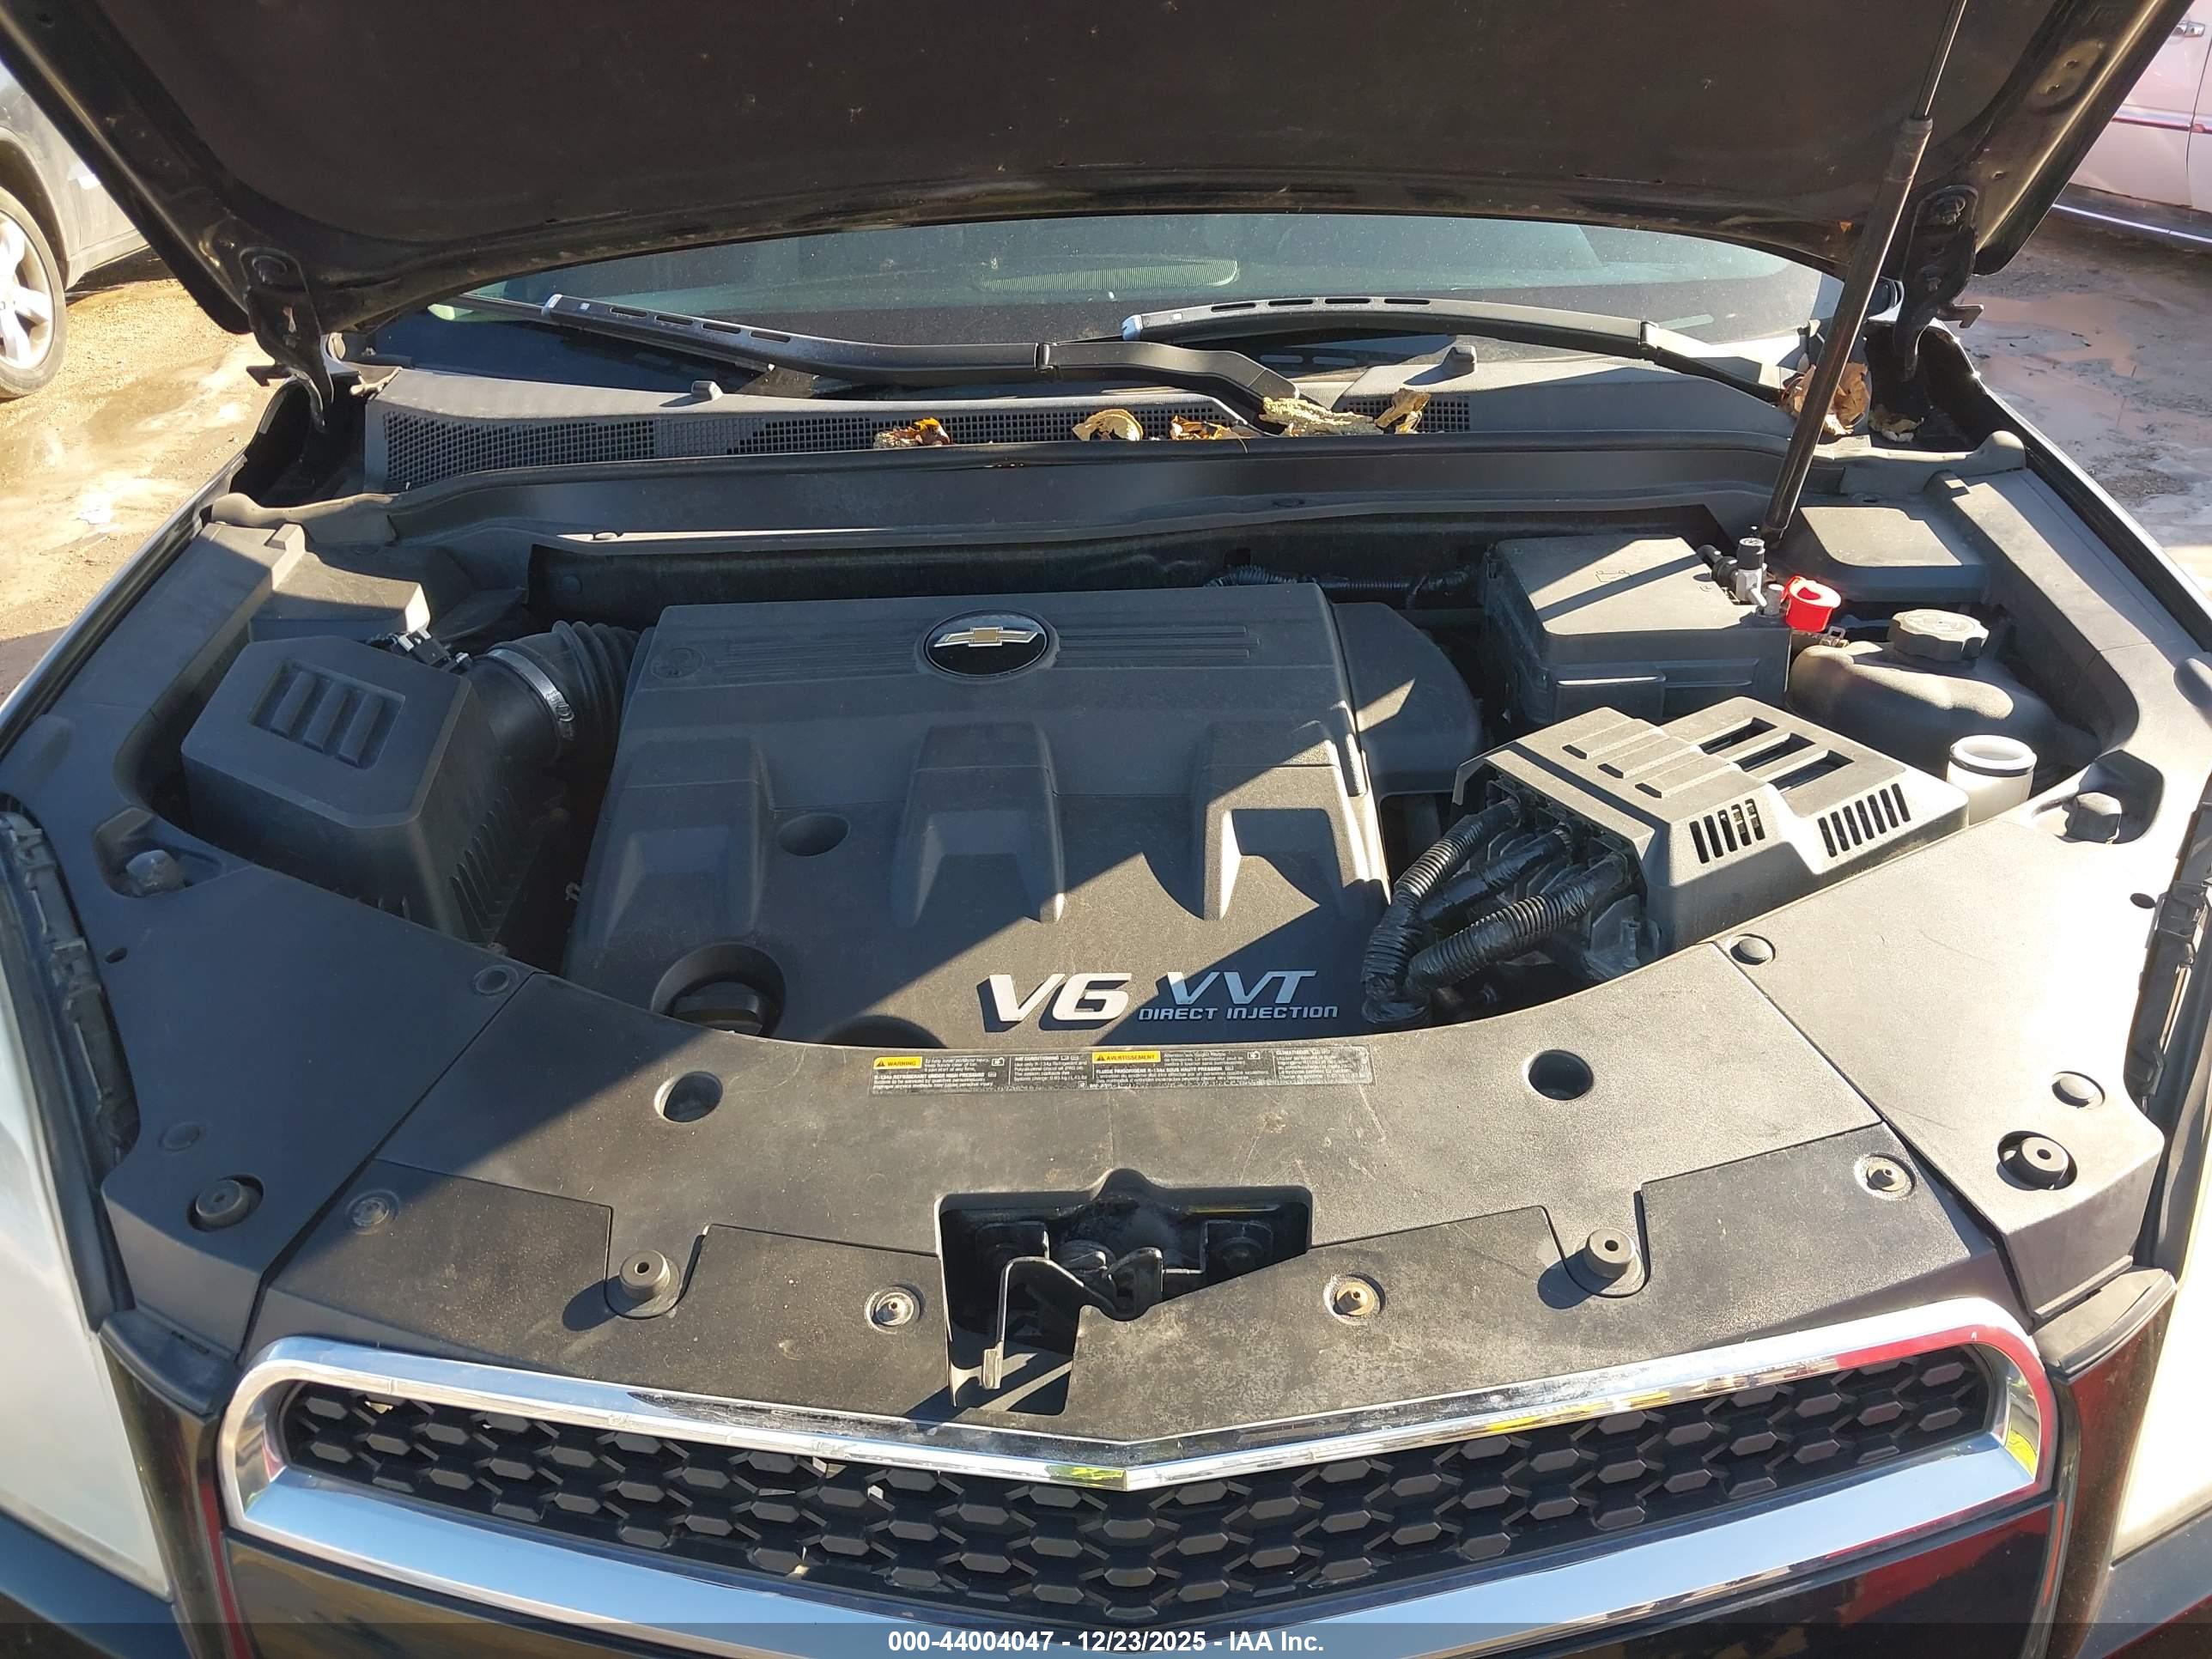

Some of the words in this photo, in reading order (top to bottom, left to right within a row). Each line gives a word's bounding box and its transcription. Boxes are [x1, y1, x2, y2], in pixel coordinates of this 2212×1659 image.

[988, 971, 1133, 1023] V6
[1166, 970, 1317, 1005] VVT
[1138, 1006, 1218, 1021] DIRECT
[1226, 1005, 1339, 1019] INJECTION
